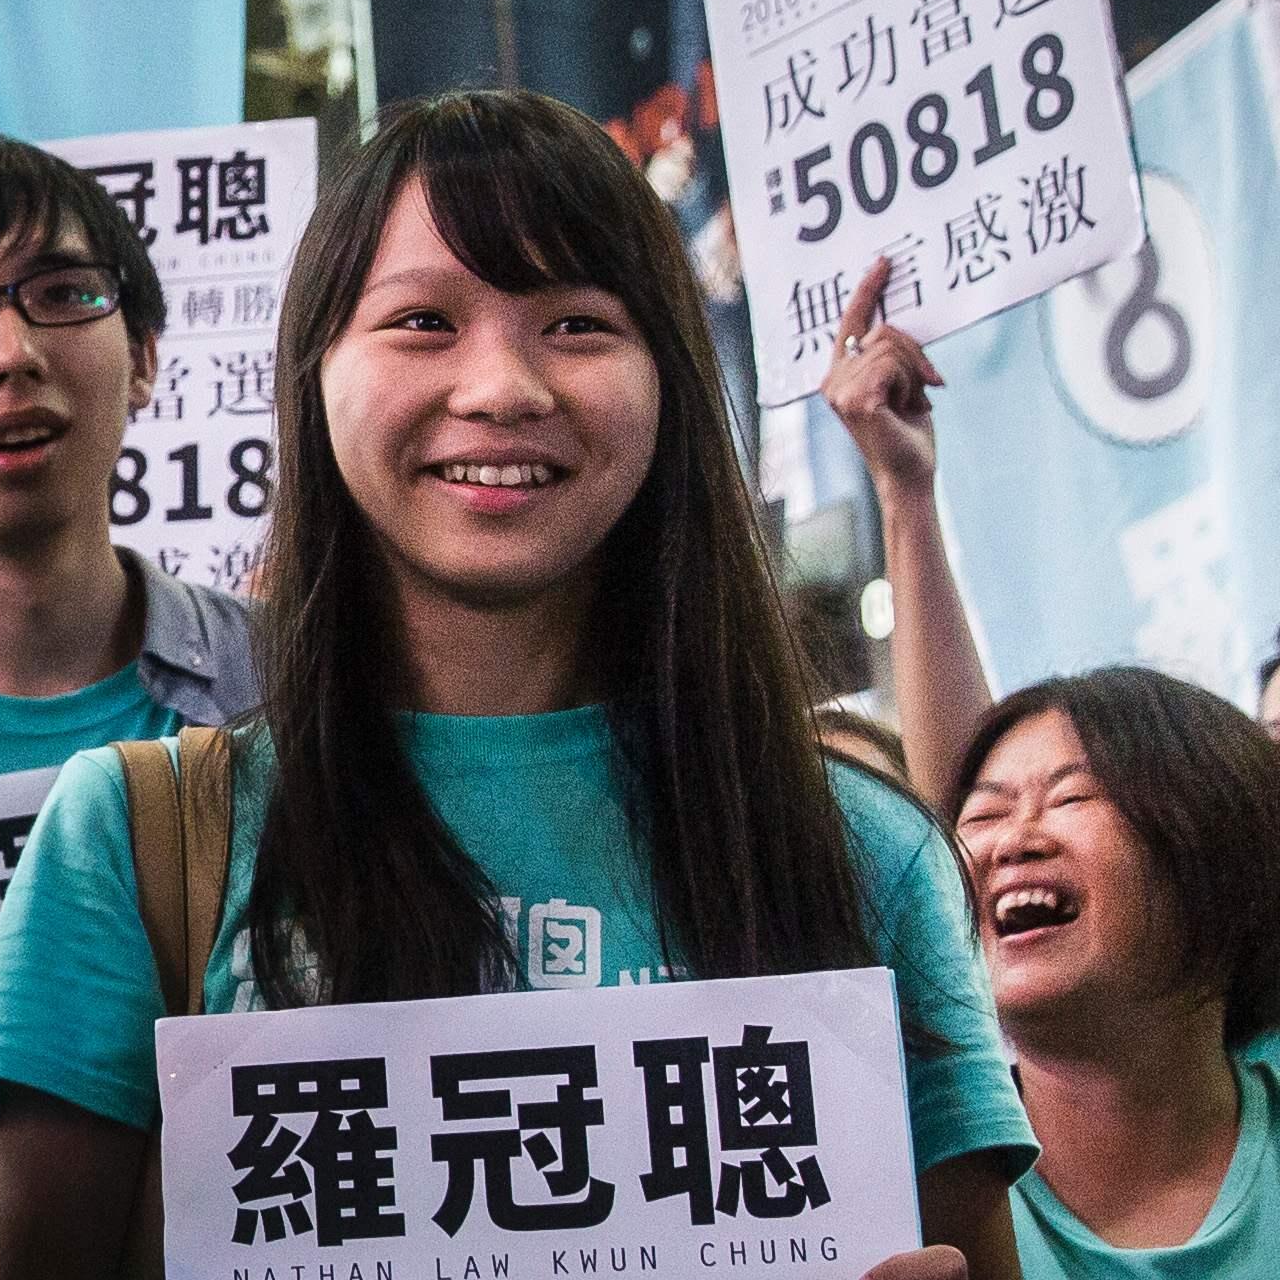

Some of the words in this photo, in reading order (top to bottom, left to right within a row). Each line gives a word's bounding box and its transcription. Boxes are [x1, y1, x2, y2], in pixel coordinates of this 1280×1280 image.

[793, 32, 1076, 245] 50818
[785, 154, 1096, 362] 無言感激
[225, 1023, 834, 1249] 羅冠聰
[551, 1243, 660, 1277] KWUN
[699, 1234, 842, 1268] CHUNG
